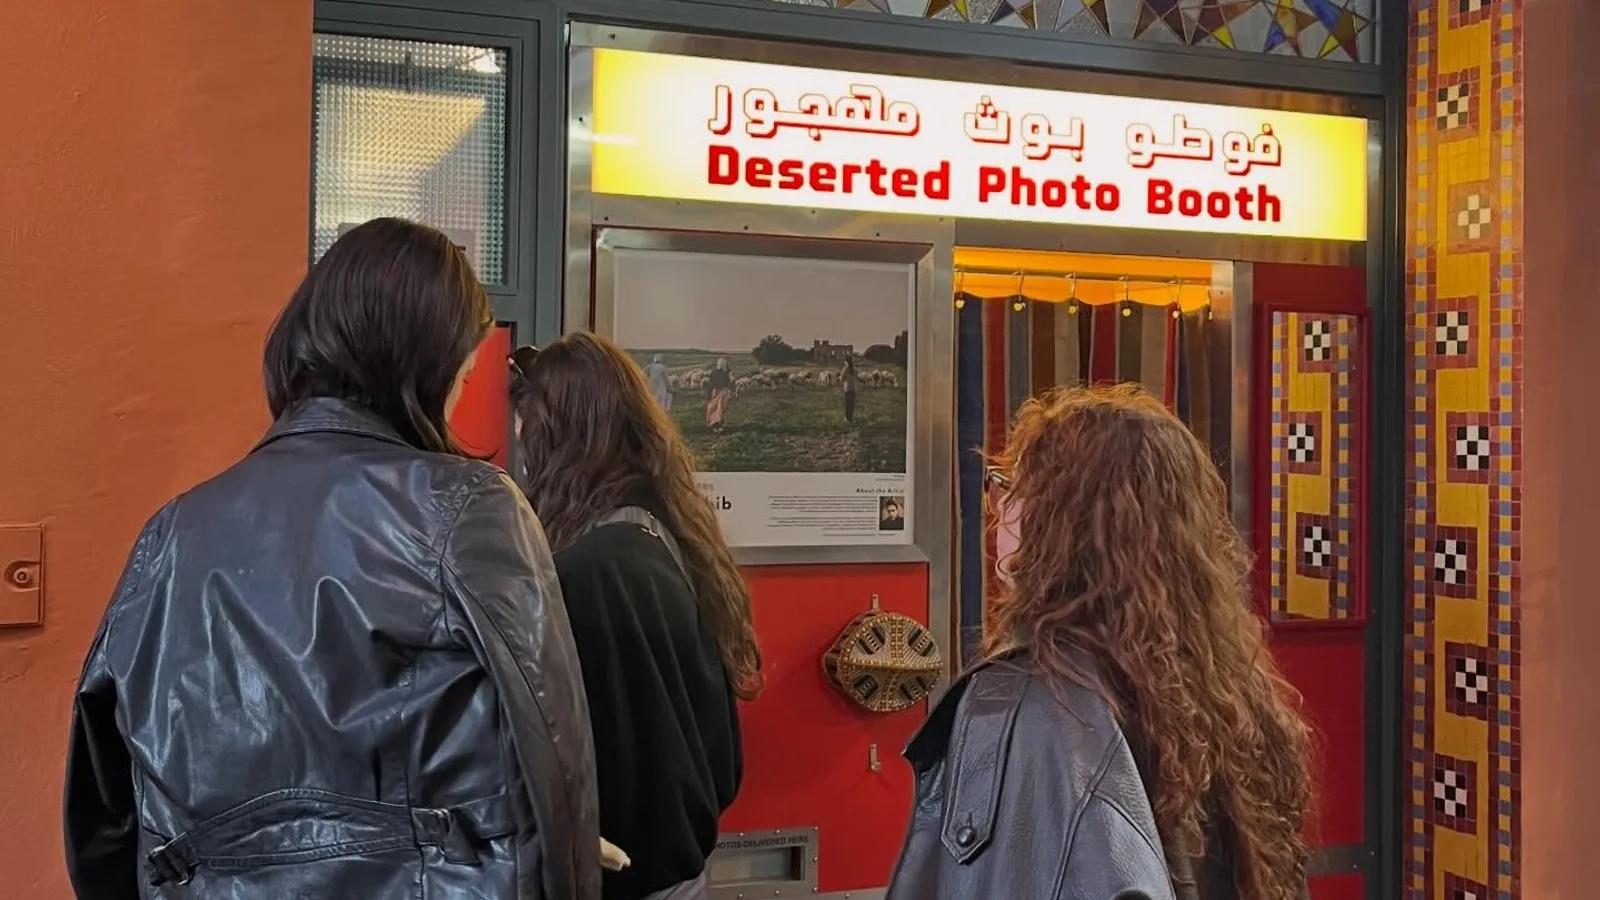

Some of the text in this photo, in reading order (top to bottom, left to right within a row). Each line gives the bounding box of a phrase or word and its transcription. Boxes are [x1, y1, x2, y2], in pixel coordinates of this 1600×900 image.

[708, 84, 1282, 177] فوطو بوث مهجور
[708, 145, 1282, 222] Deserted Photo Booth
[744, 838, 787, 848] DELIVERED
